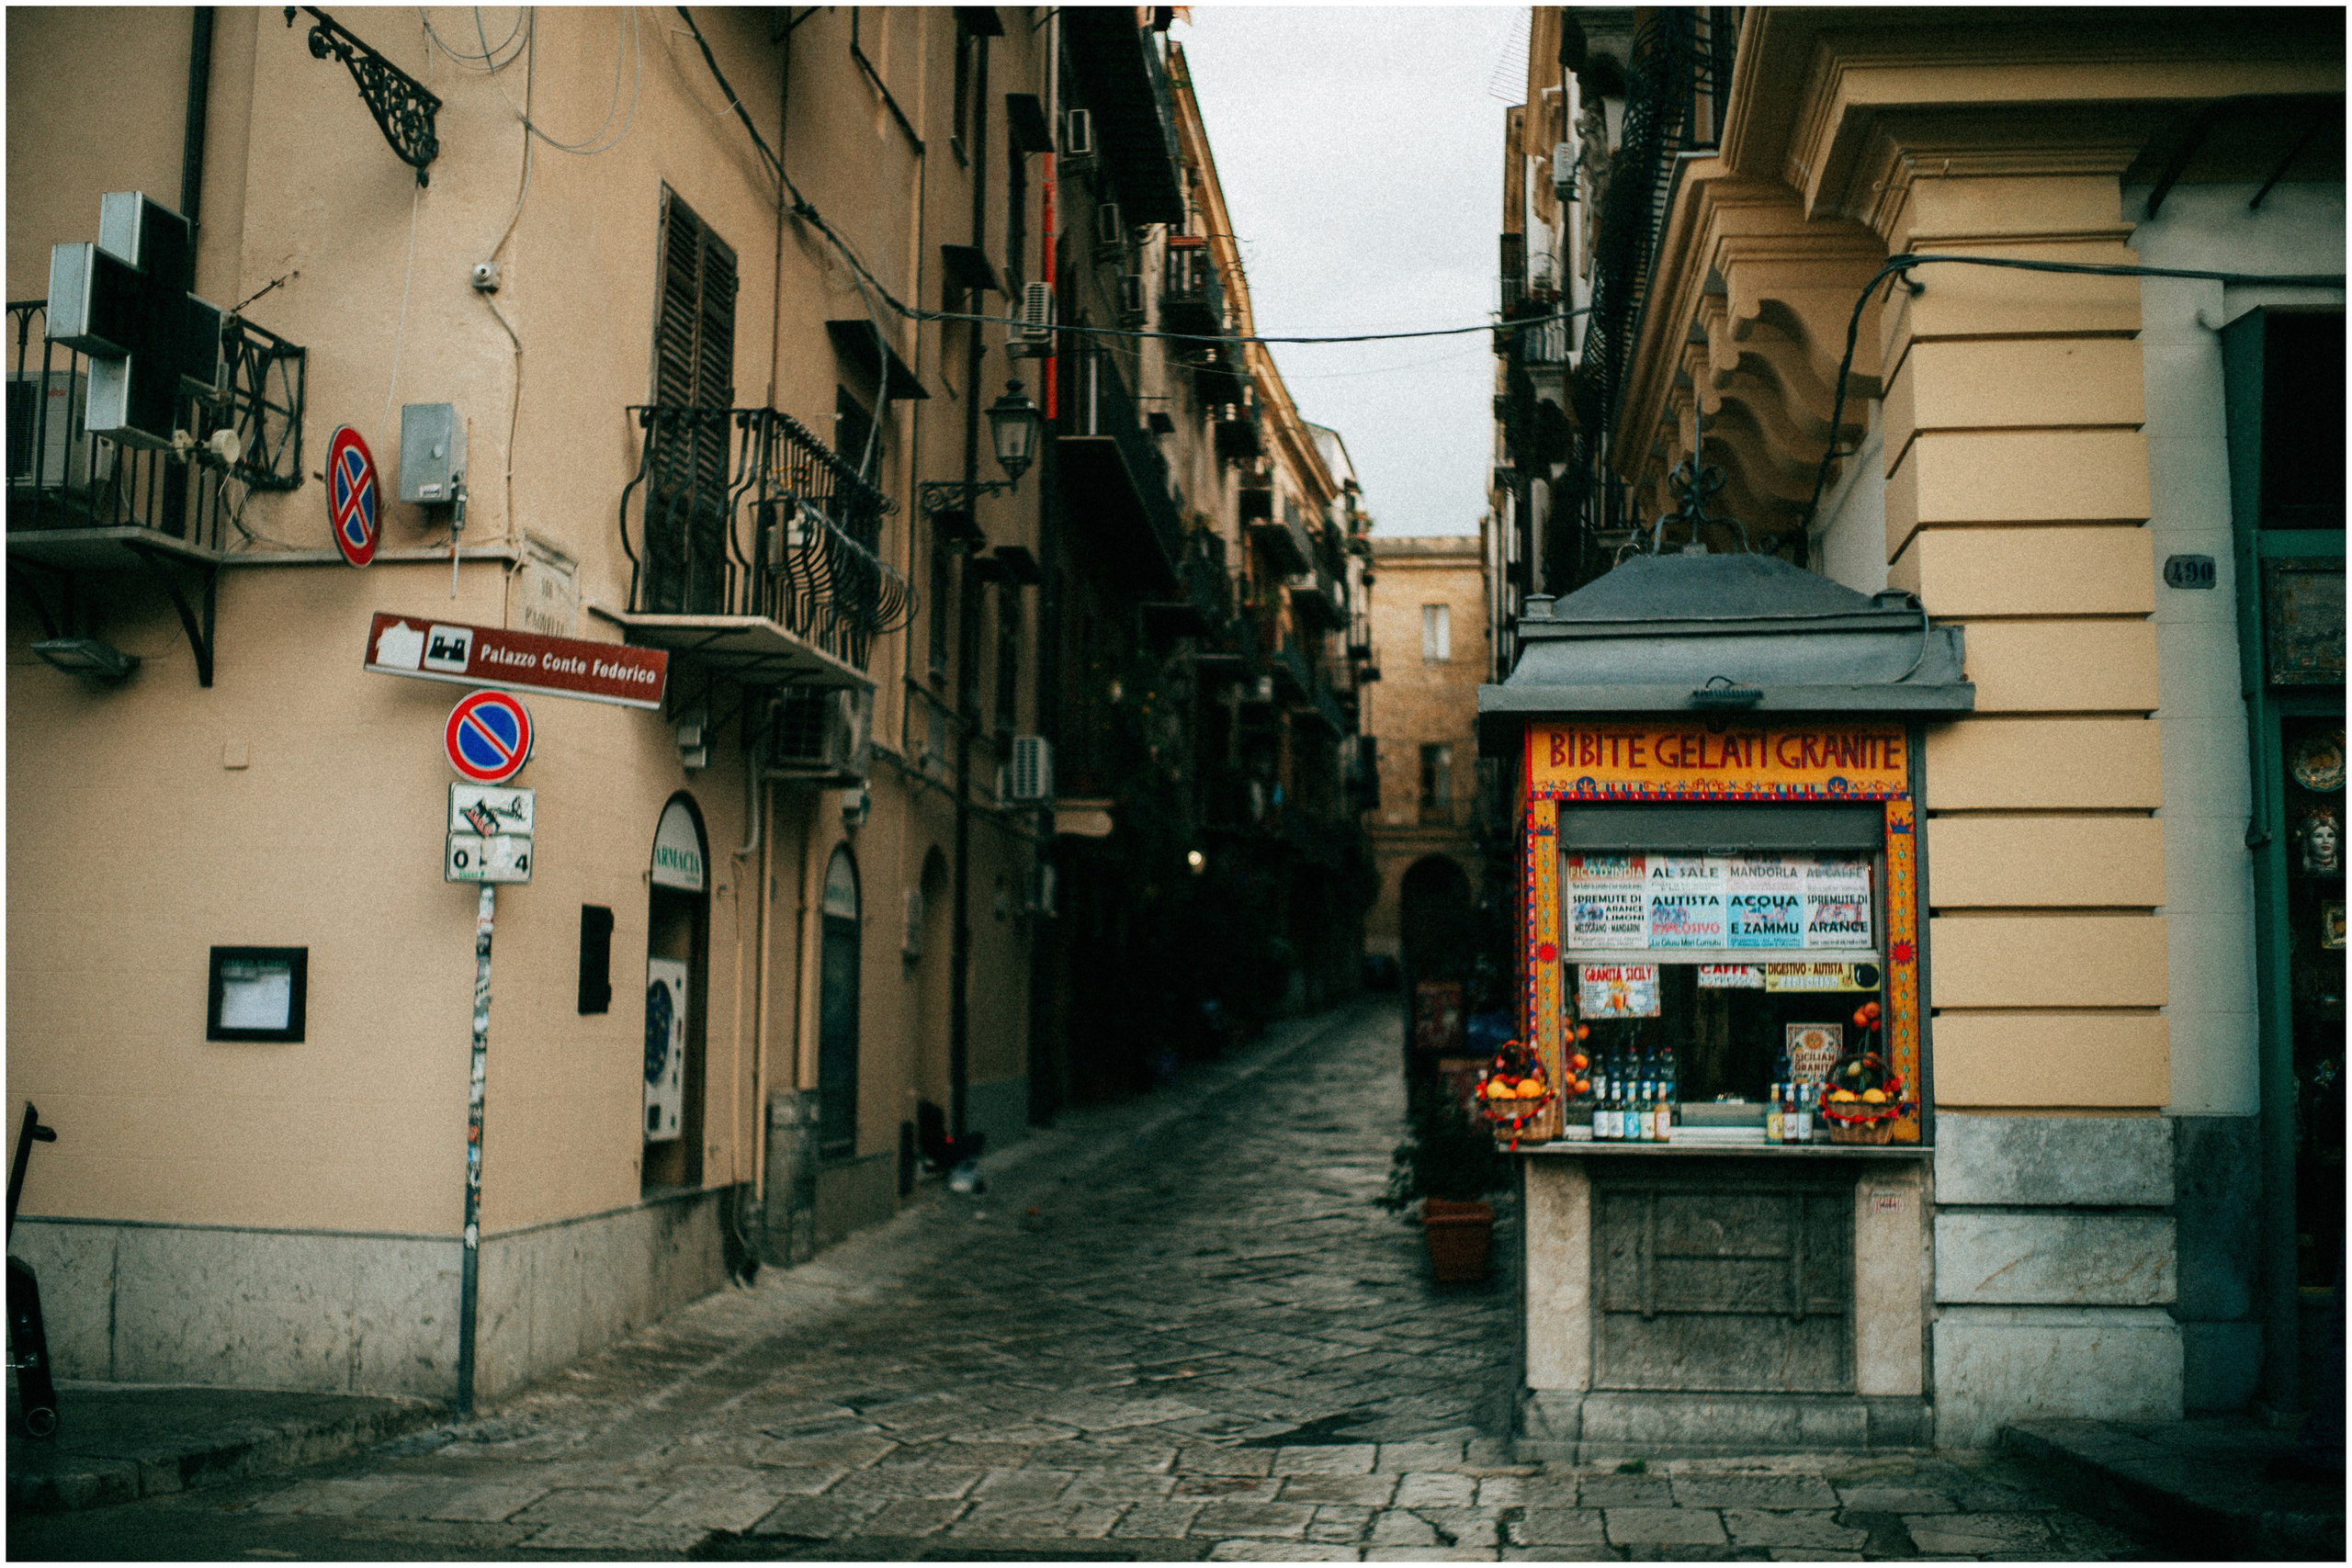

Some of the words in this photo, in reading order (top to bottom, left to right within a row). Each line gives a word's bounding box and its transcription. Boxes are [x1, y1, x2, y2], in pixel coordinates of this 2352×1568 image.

[2172, 561, 2213, 583] 490
[480, 644, 537, 669] Palazzo
[542, 651, 587, 675] Conte
[592, 658, 657, 684] Federico
[1550, 728, 1647, 769] BIBITE
[1655, 728, 1768, 770] GELATI
[1776, 728, 1902, 770] GRANITE
[1679, 867, 1719, 878] SALE
[1730, 866, 1798, 877] MANDORLA
[1573, 895, 1627, 904] SPREMUTE
[1630, 895, 1642, 904] DI
[1652, 896, 1720, 907] AUTISTA
[1731, 896, 1799, 908] ACQUA
[1807, 895, 1854, 905] SPREMUTE
[1858, 895, 1868, 905] DI
[1606, 905, 1644, 913] ARANCE
[1652, 922, 1720, 934] ESPLOSIVO
[1731, 922, 1739, 934] E
[1744, 922, 1799, 934] ZAMMU
[1809, 921, 1868, 932] ARANCE
[1585, 965, 1622, 981] GRANITA
[1625, 965, 1652, 981] SICILY
[1768, 964, 1806, 975] DIGESTIVO
[1814, 964, 1843, 975] AUTISTA
